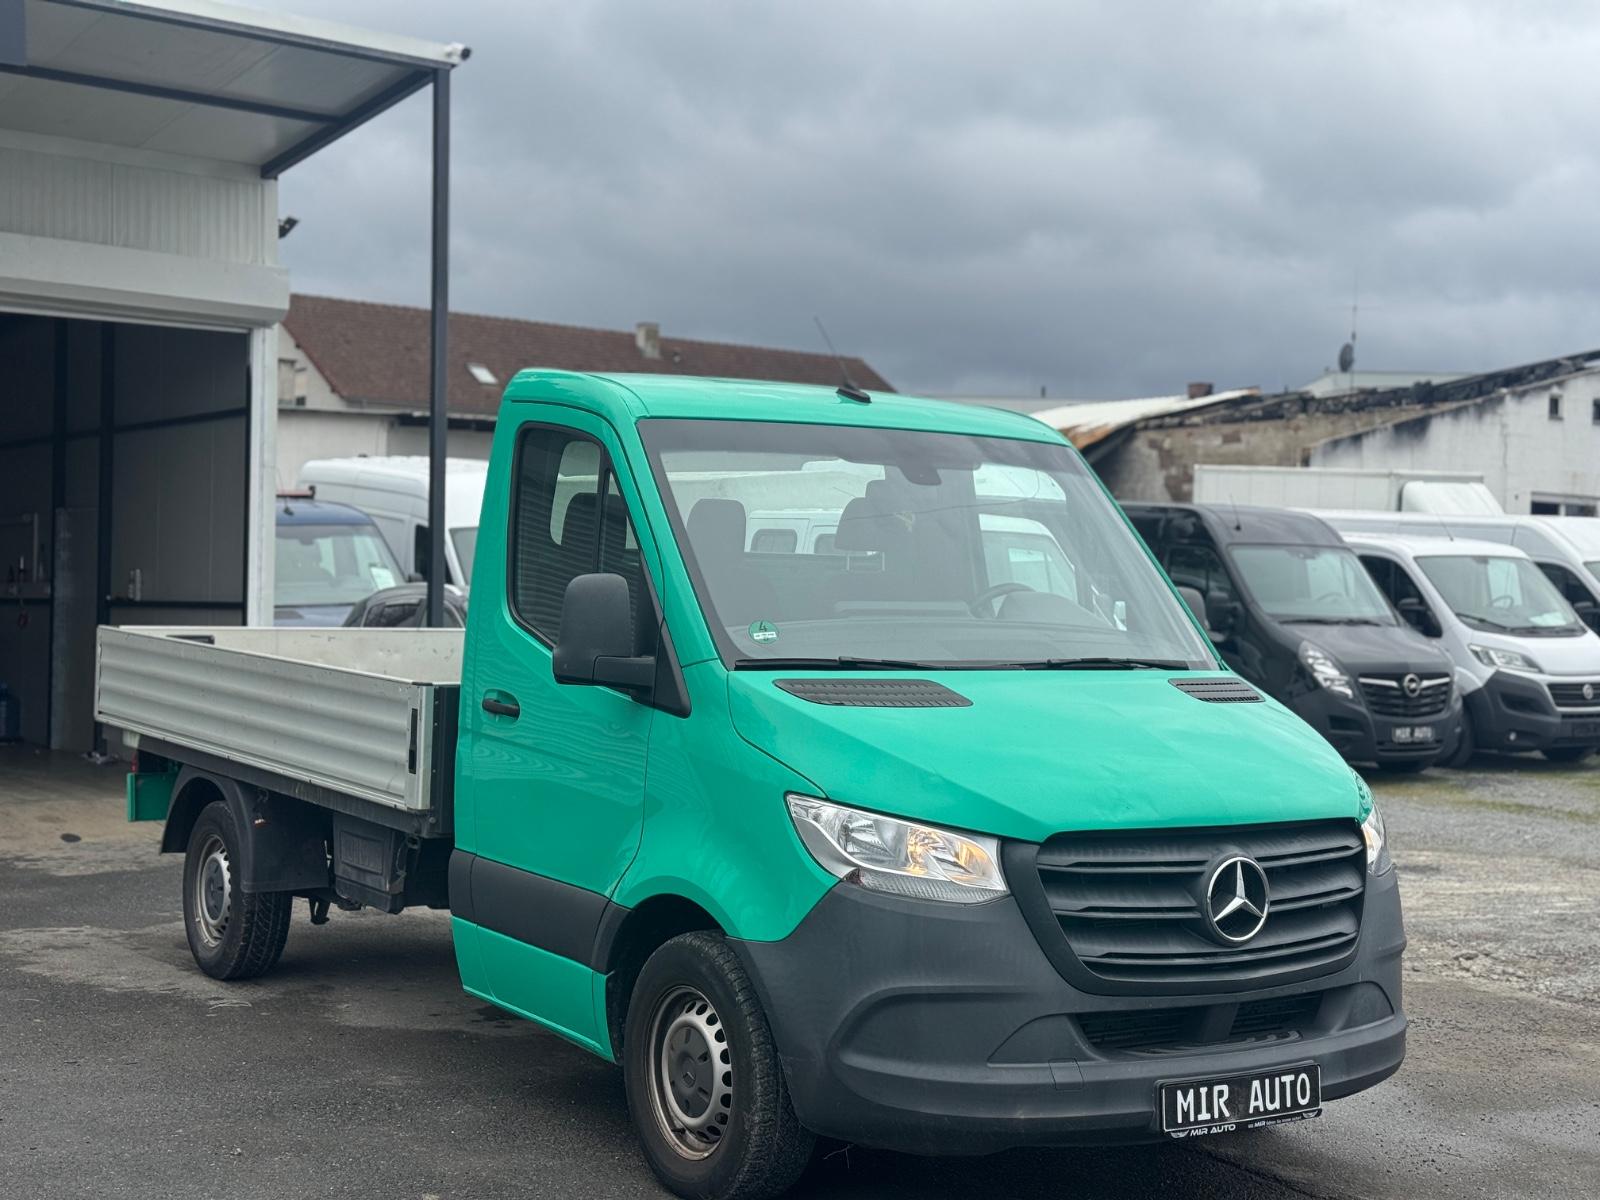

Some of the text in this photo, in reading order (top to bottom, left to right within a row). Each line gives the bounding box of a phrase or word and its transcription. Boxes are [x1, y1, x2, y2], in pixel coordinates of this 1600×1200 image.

[759, 620, 768, 632] 4
[1176, 1073, 1311, 1123] MIR AUTO
[1190, 1128, 1209, 1137] MIR
[1210, 1123, 1236, 1134] AUTO
